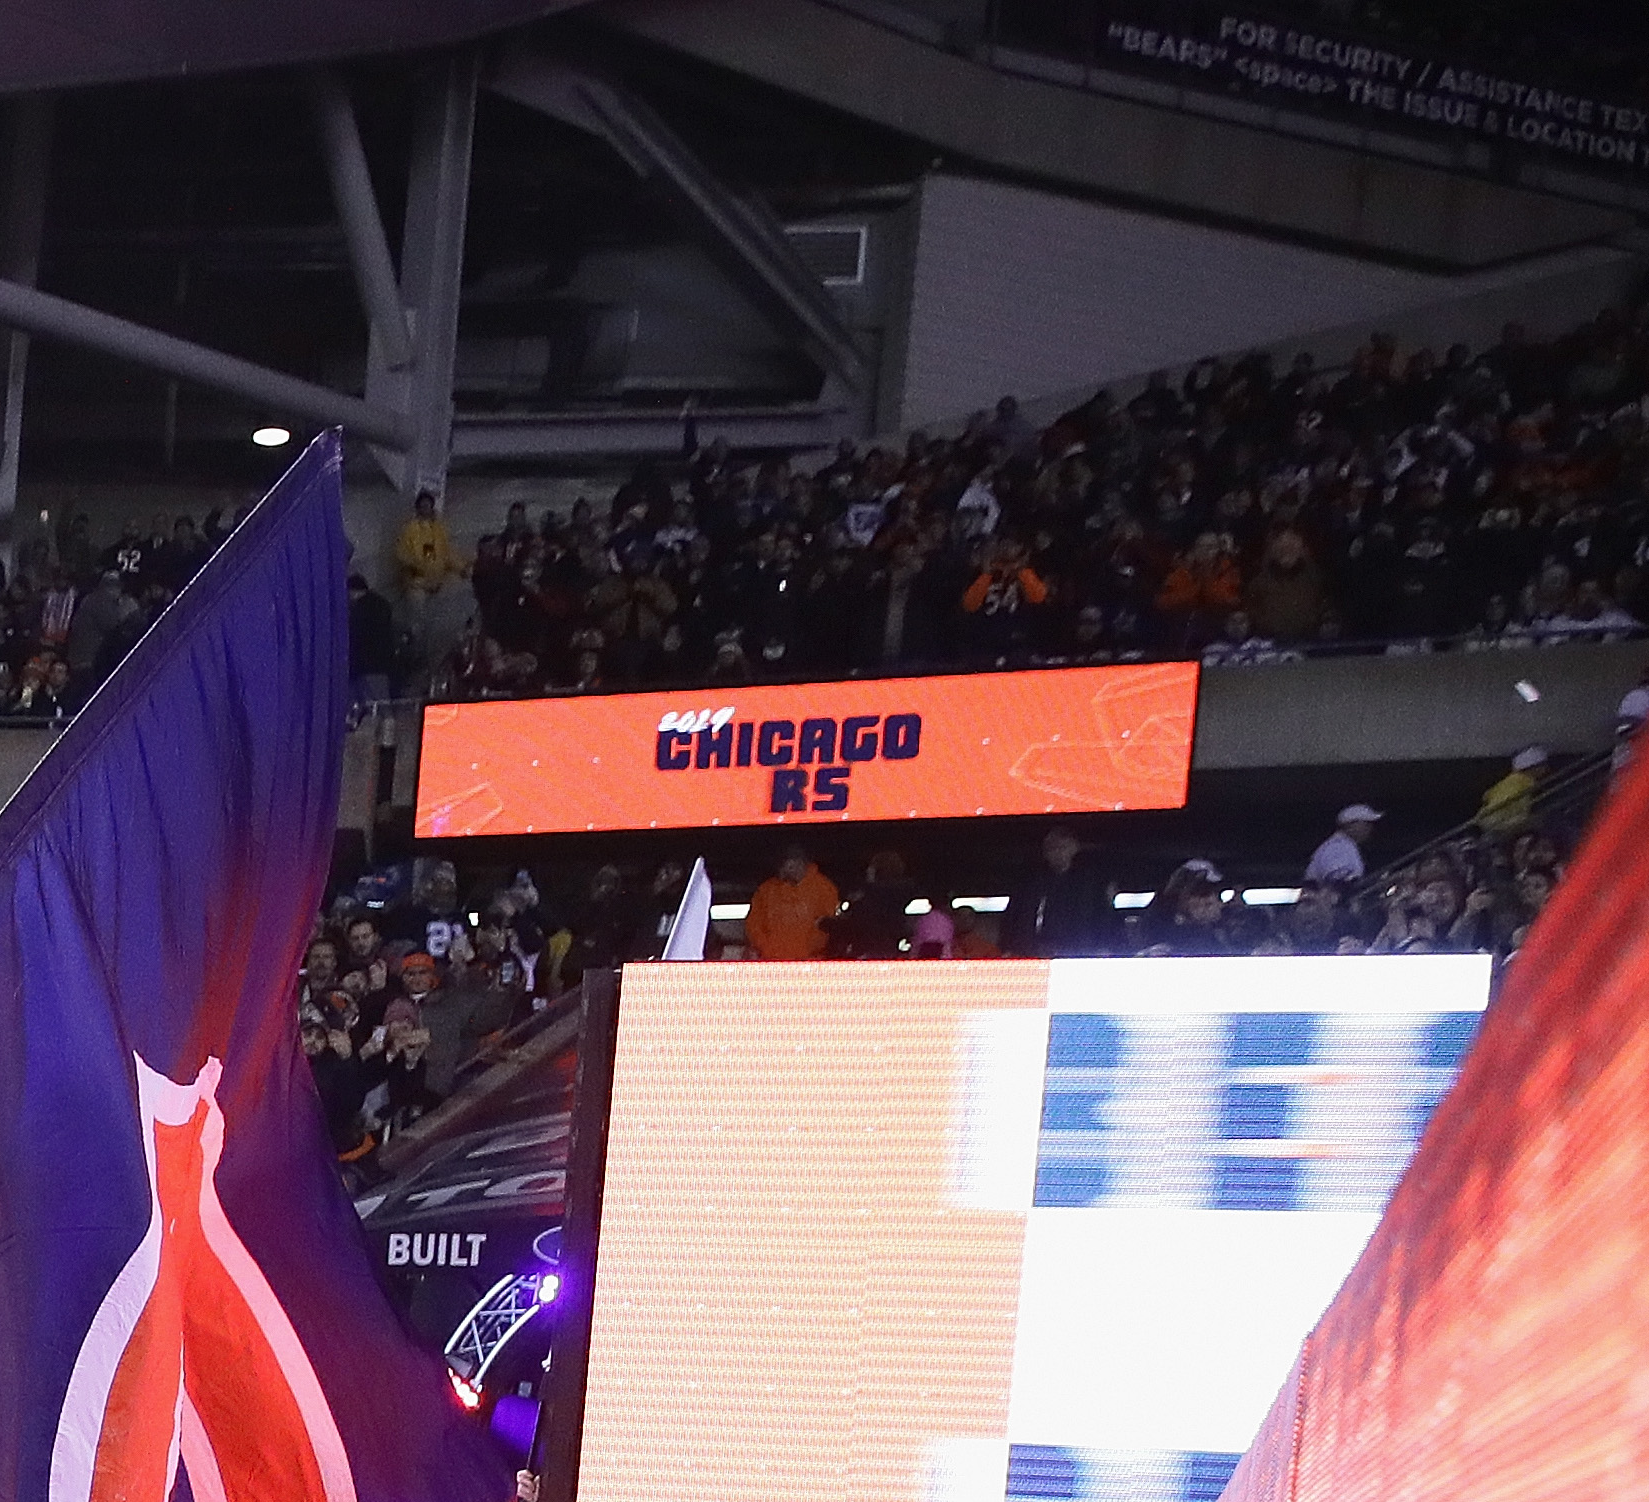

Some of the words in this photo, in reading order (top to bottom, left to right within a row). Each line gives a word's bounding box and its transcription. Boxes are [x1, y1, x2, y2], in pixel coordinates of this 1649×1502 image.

[1219, 16, 1278, 51] FOR
[1284, 28, 1414, 83] SECURITY
[1437, 67, 1594, 124] ASSISTANCE
[1346, 75, 1398, 110] THE
[1402, 90, 1478, 129] ISSUE
[1505, 113, 1636, 163] LOCATION
[657, 712, 922, 770] CHICAGO
[770, 766, 850, 813] RS
[387, 1232, 487, 1267] BUILT
